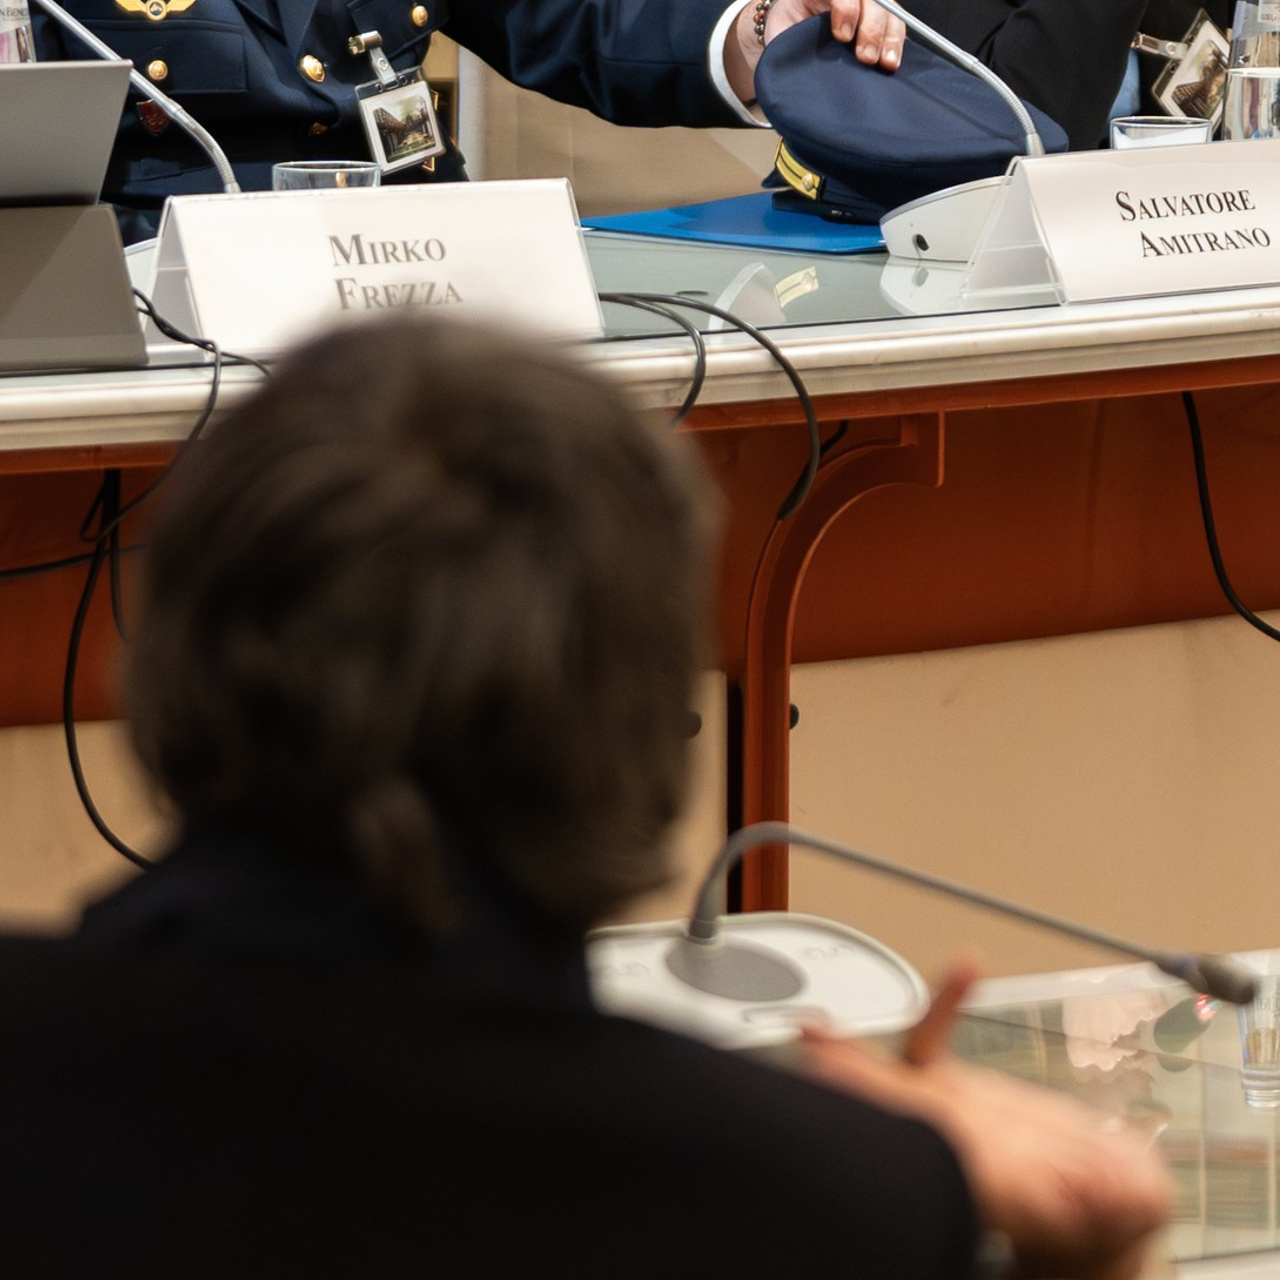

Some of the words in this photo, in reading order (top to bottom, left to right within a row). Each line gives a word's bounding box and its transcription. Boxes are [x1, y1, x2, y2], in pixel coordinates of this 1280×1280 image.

[1116, 190, 1256, 222] SALVATORE
[329, 233, 446, 266] MIRKO
[1141, 227, 1271, 258] AMITRANO
[334, 277, 464, 311] FREZZA
